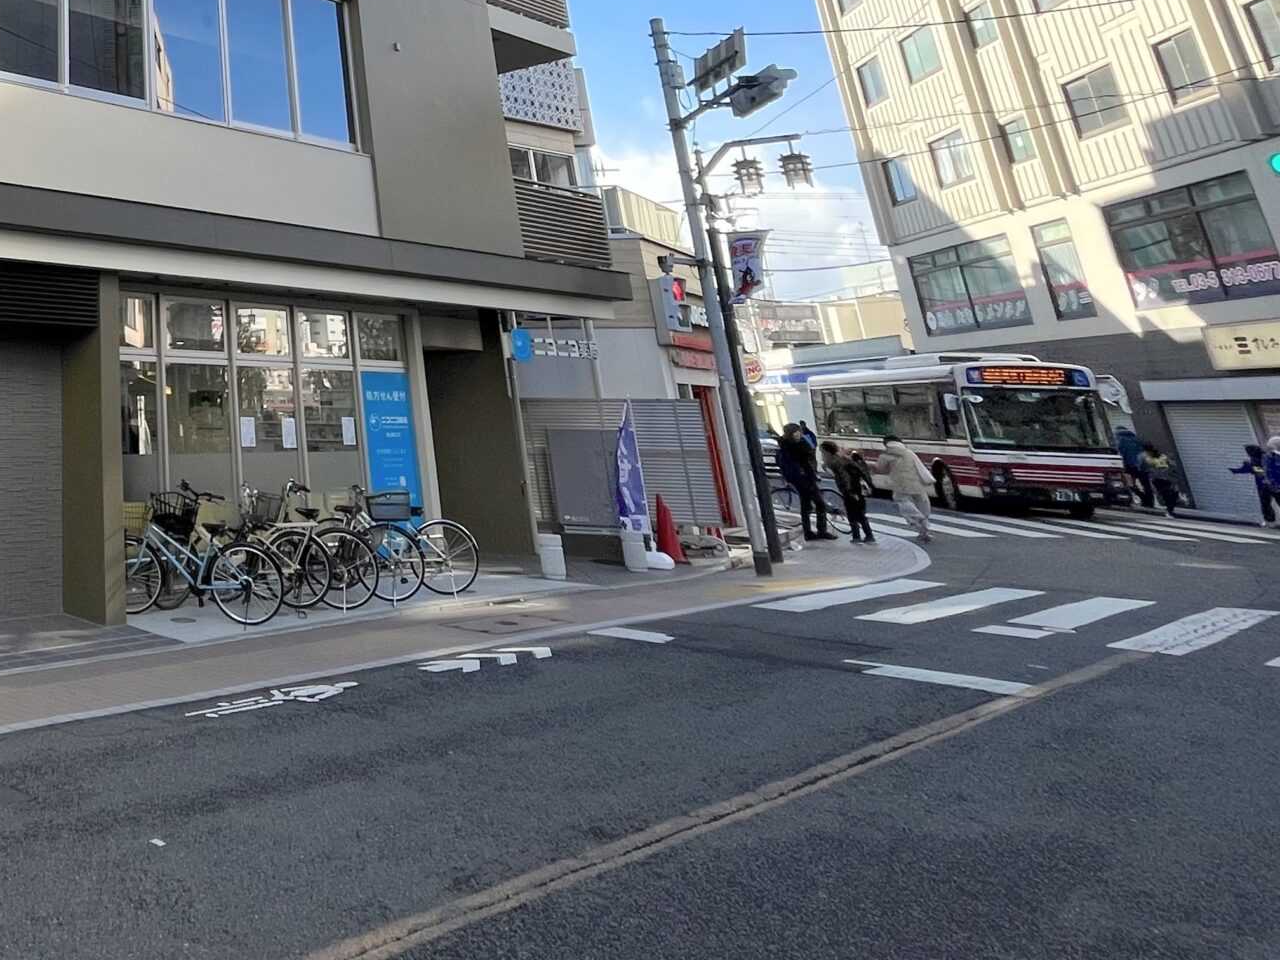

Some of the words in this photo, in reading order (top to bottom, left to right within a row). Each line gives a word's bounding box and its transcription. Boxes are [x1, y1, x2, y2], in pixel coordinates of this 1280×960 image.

[533, 338, 599, 360] ニコニコ薬局
